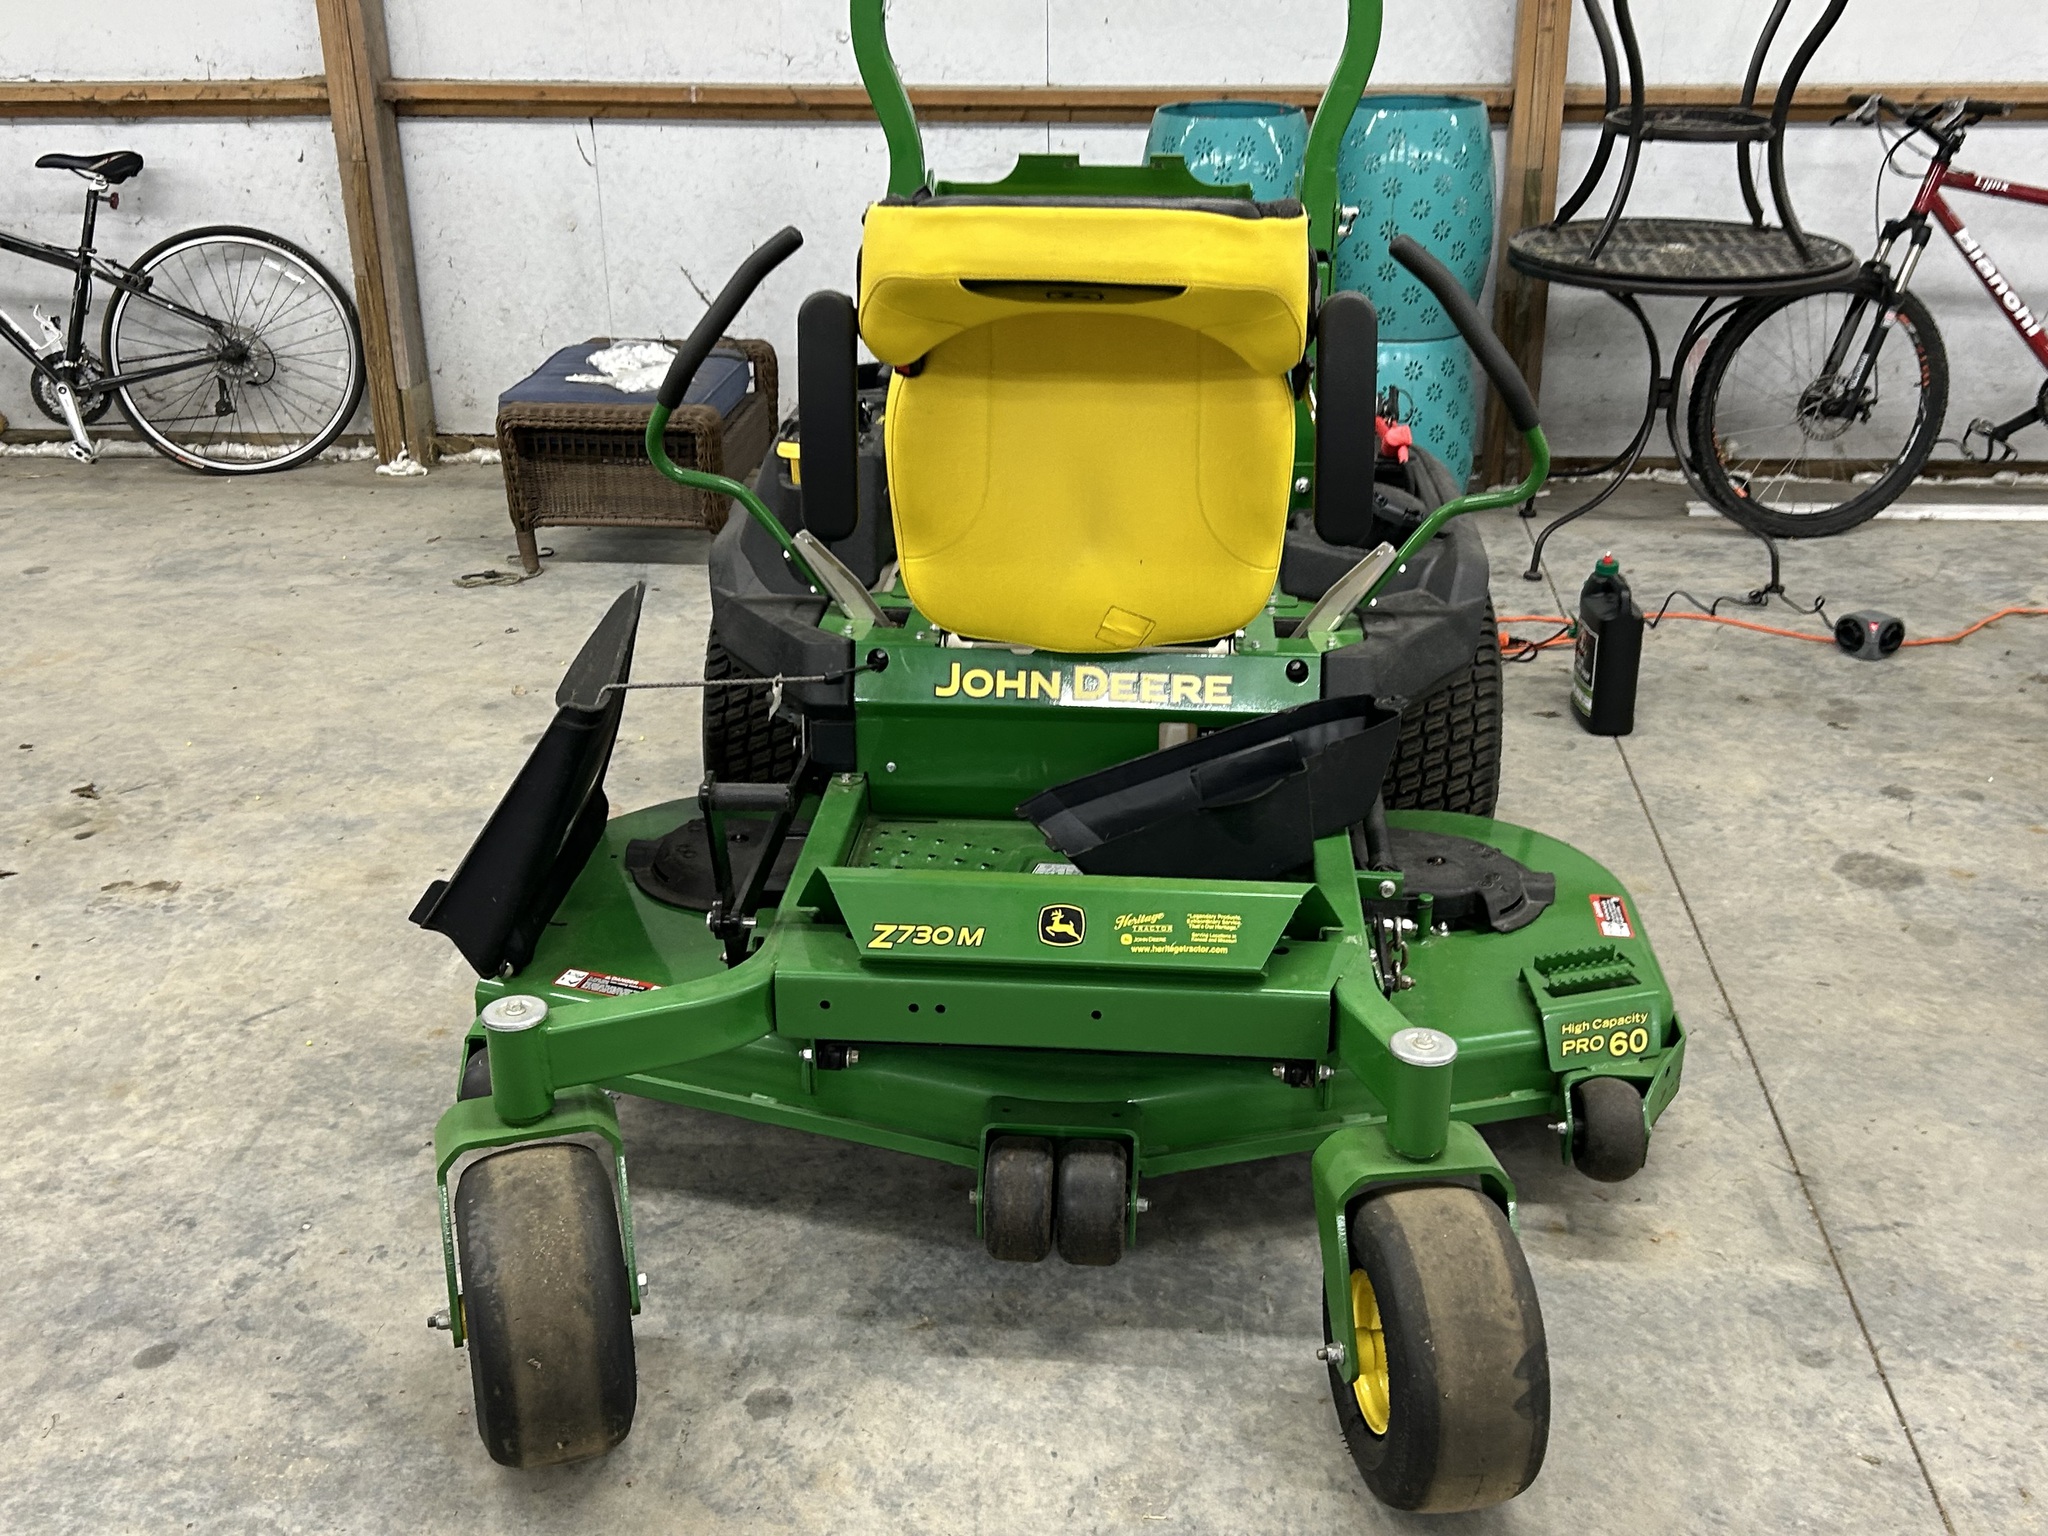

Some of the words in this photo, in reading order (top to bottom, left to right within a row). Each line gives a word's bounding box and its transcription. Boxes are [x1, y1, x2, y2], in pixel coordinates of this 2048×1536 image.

[934, 662, 1063, 700] JOHN
[1072, 664, 1234, 706] DEERE
[1113, 912, 1165, 930] Heritage
[1132, 925, 1173, 933] TRACTOR
[1131, 943, 1229, 955] www.heritagetractor.com
[1561, 1020, 1590, 1036] High
[1592, 1012, 1649, 1030] Capacity
[1561, 1035, 1605, 1057] PRO
[1608, 1028, 1649, 1057] 60
